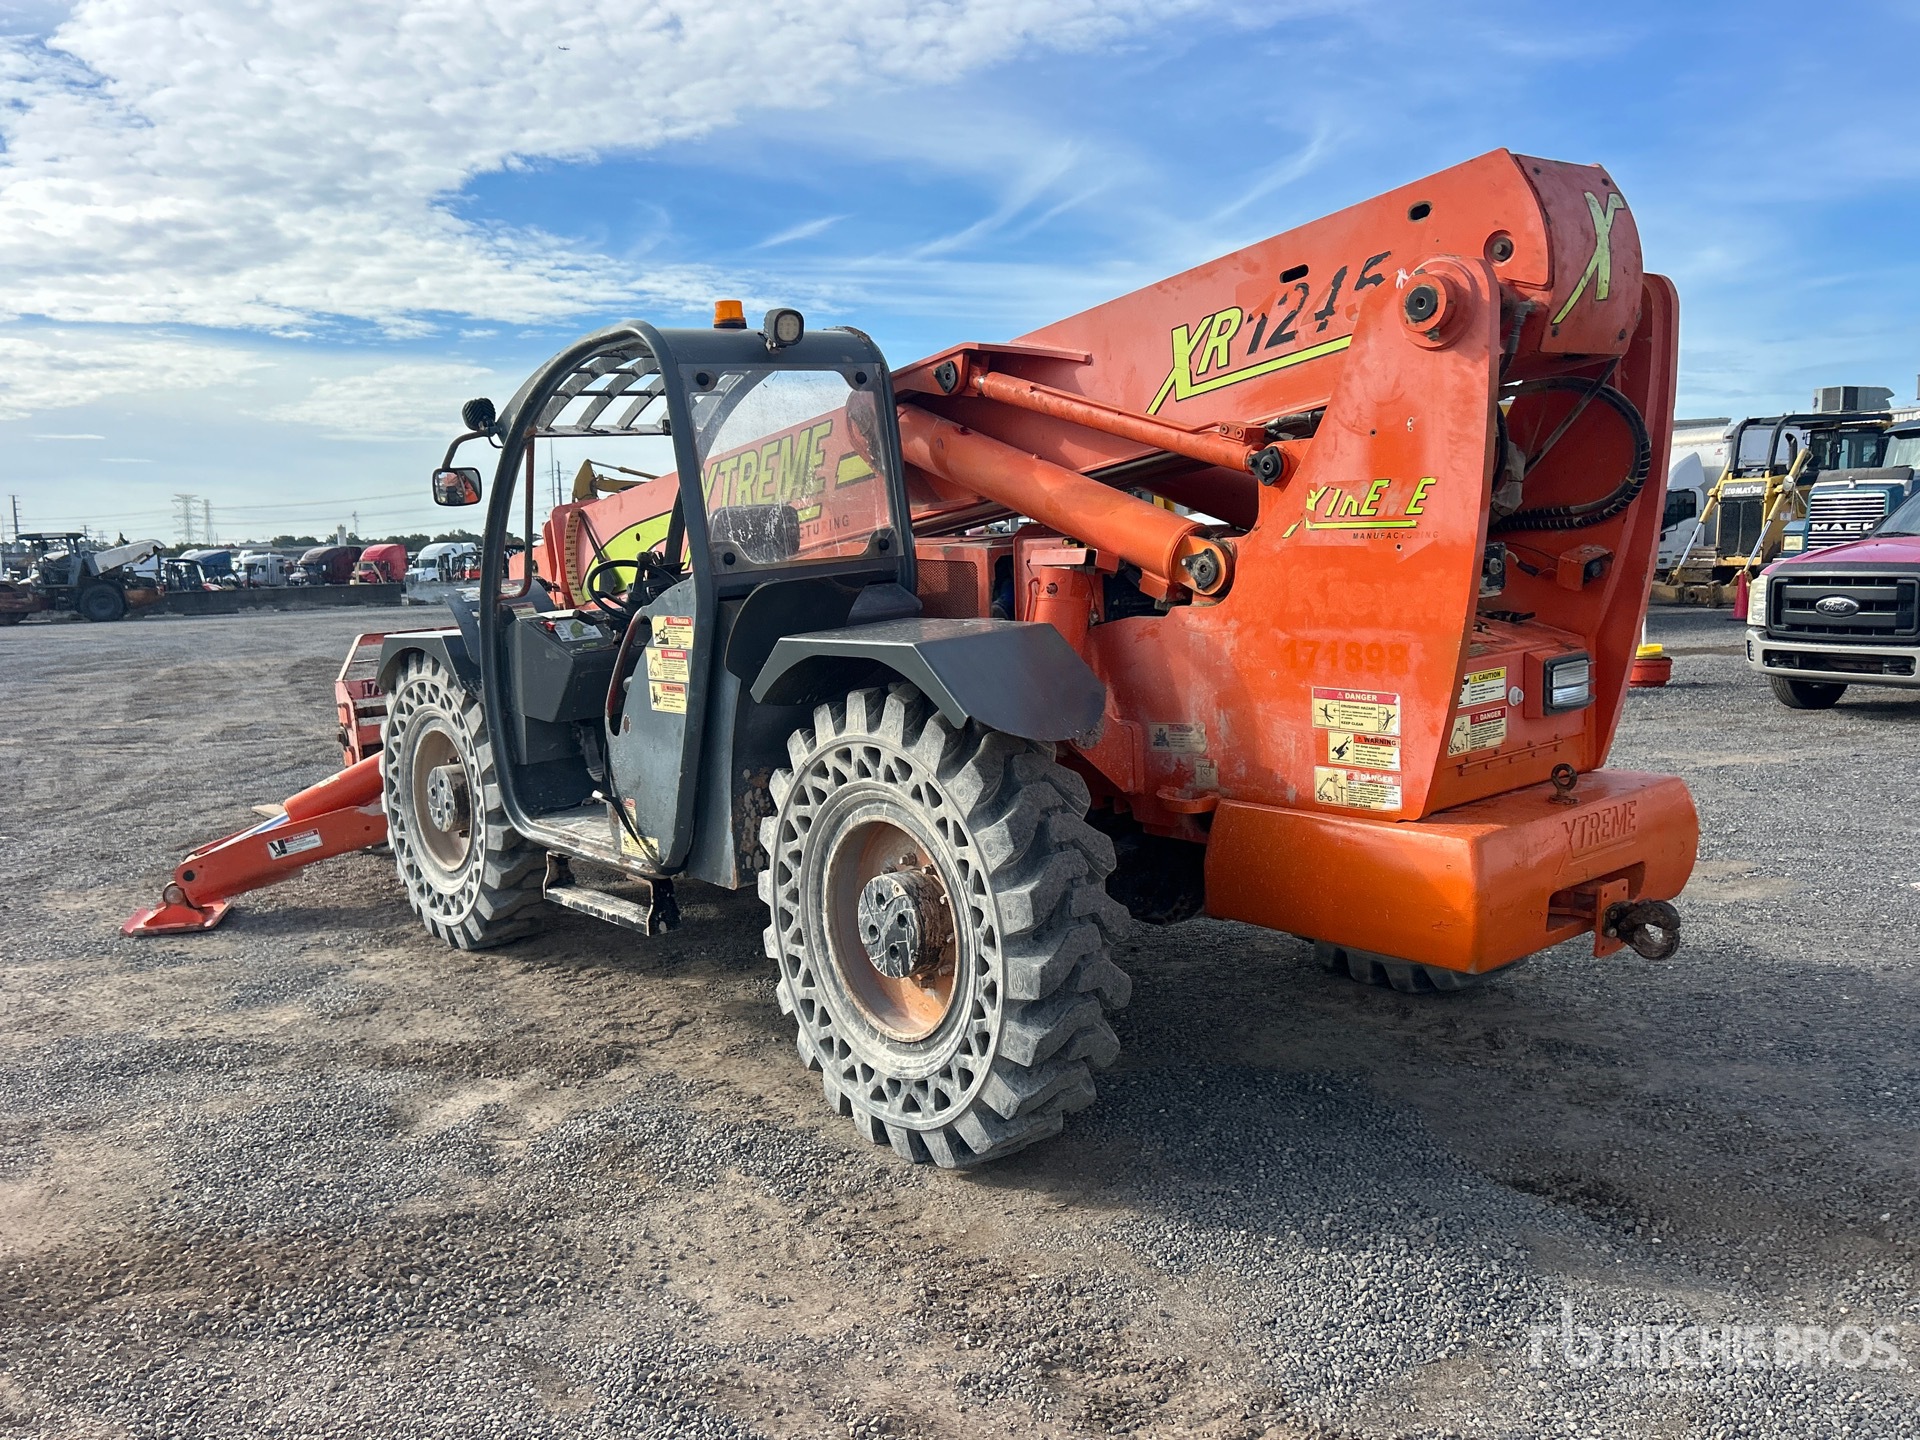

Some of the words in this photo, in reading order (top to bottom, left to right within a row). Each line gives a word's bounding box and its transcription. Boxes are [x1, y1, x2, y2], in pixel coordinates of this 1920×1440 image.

[1478, 671, 1501, 681] CAUTION
[1344, 691, 1378, 702] DANGER
[1479, 710, 1502, 721] DANGER
[1363, 736, 1397, 746] WARNING
[1360, 772, 1394, 783] DANGER
[1554, 800, 1638, 873] XTREME
